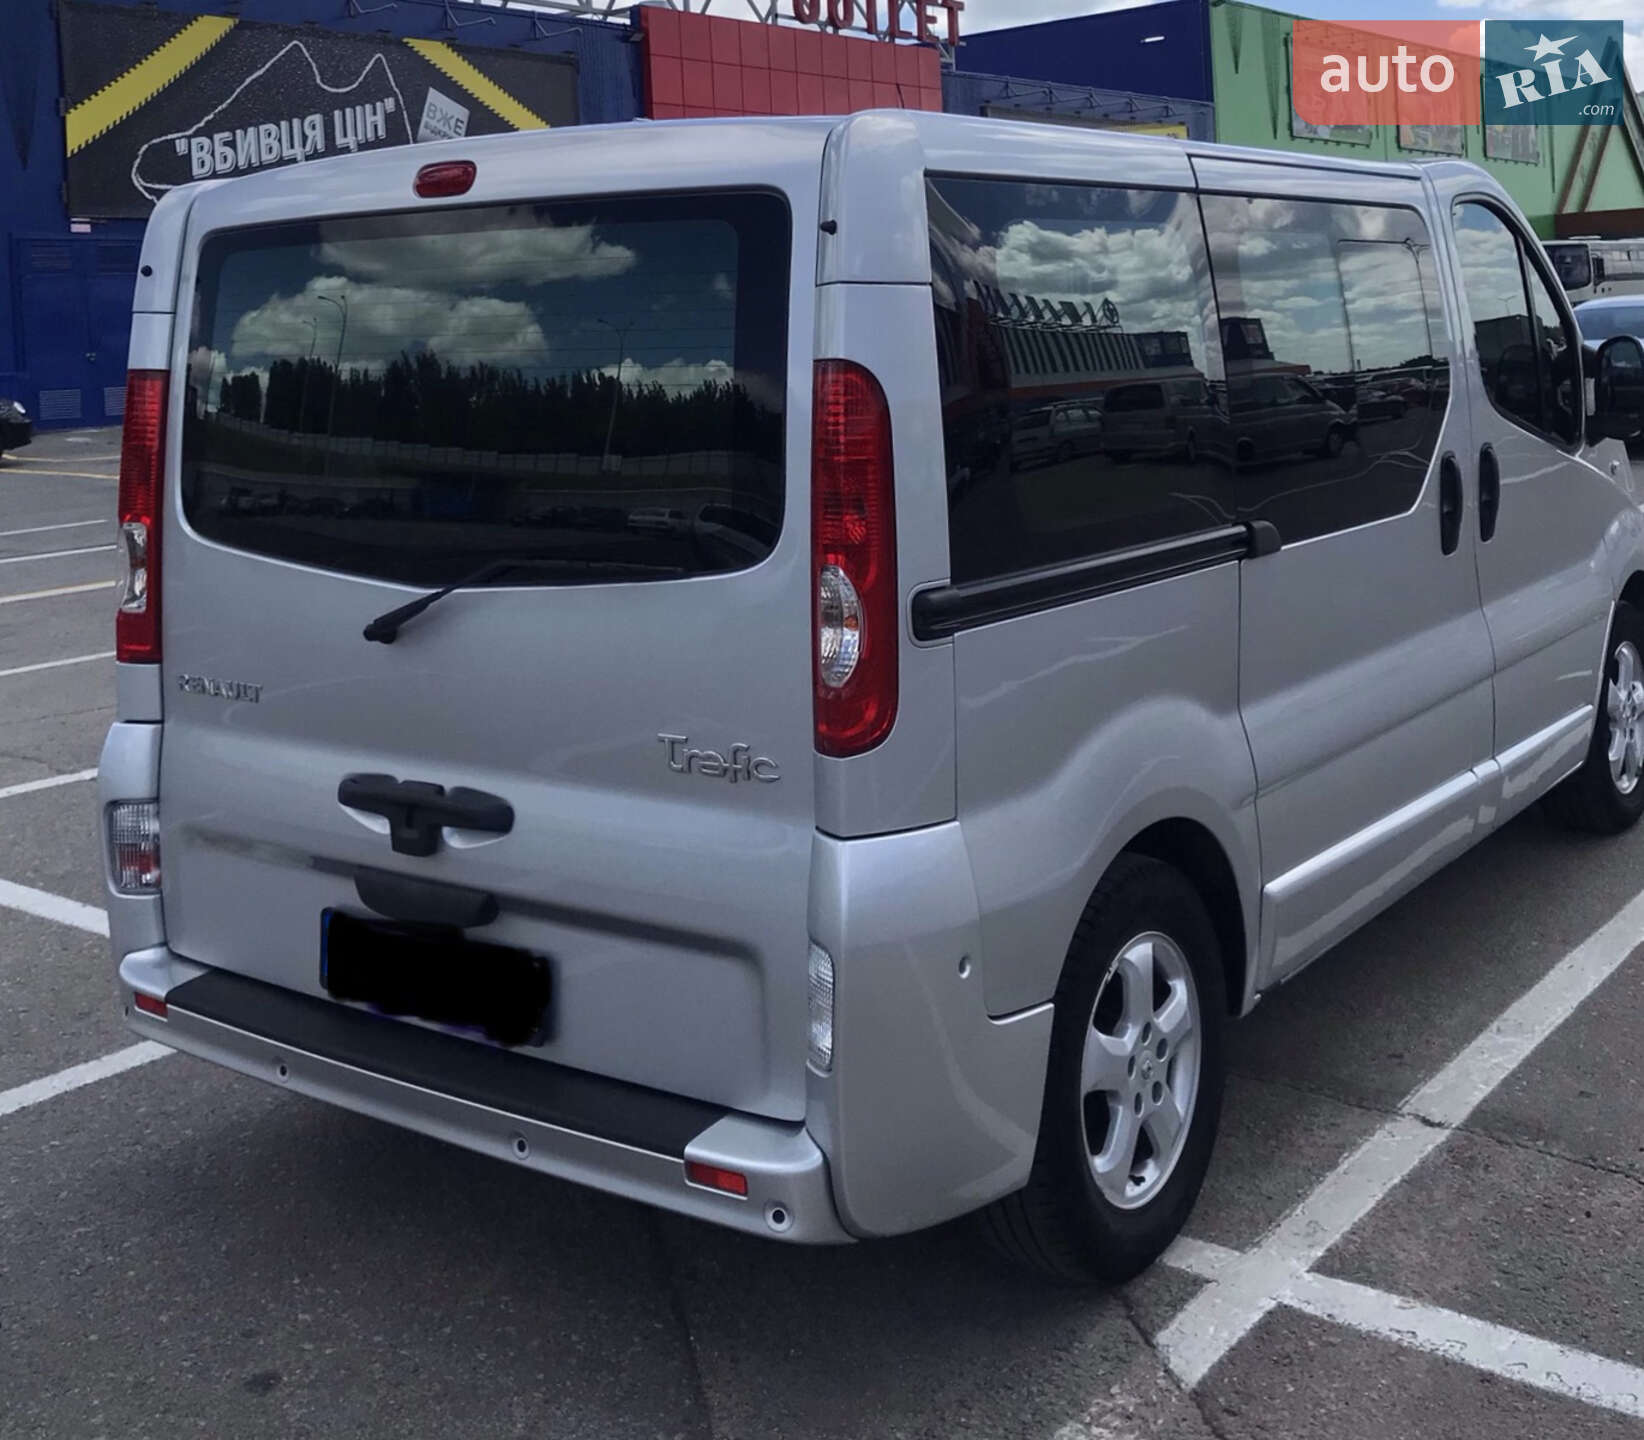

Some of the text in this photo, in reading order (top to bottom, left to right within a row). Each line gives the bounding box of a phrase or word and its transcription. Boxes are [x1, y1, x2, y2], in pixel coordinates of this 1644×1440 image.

[175, 97, 396, 180] "ВБИВЦЯ ЦІН"
[426, 102, 465, 137] ВЖЕ
